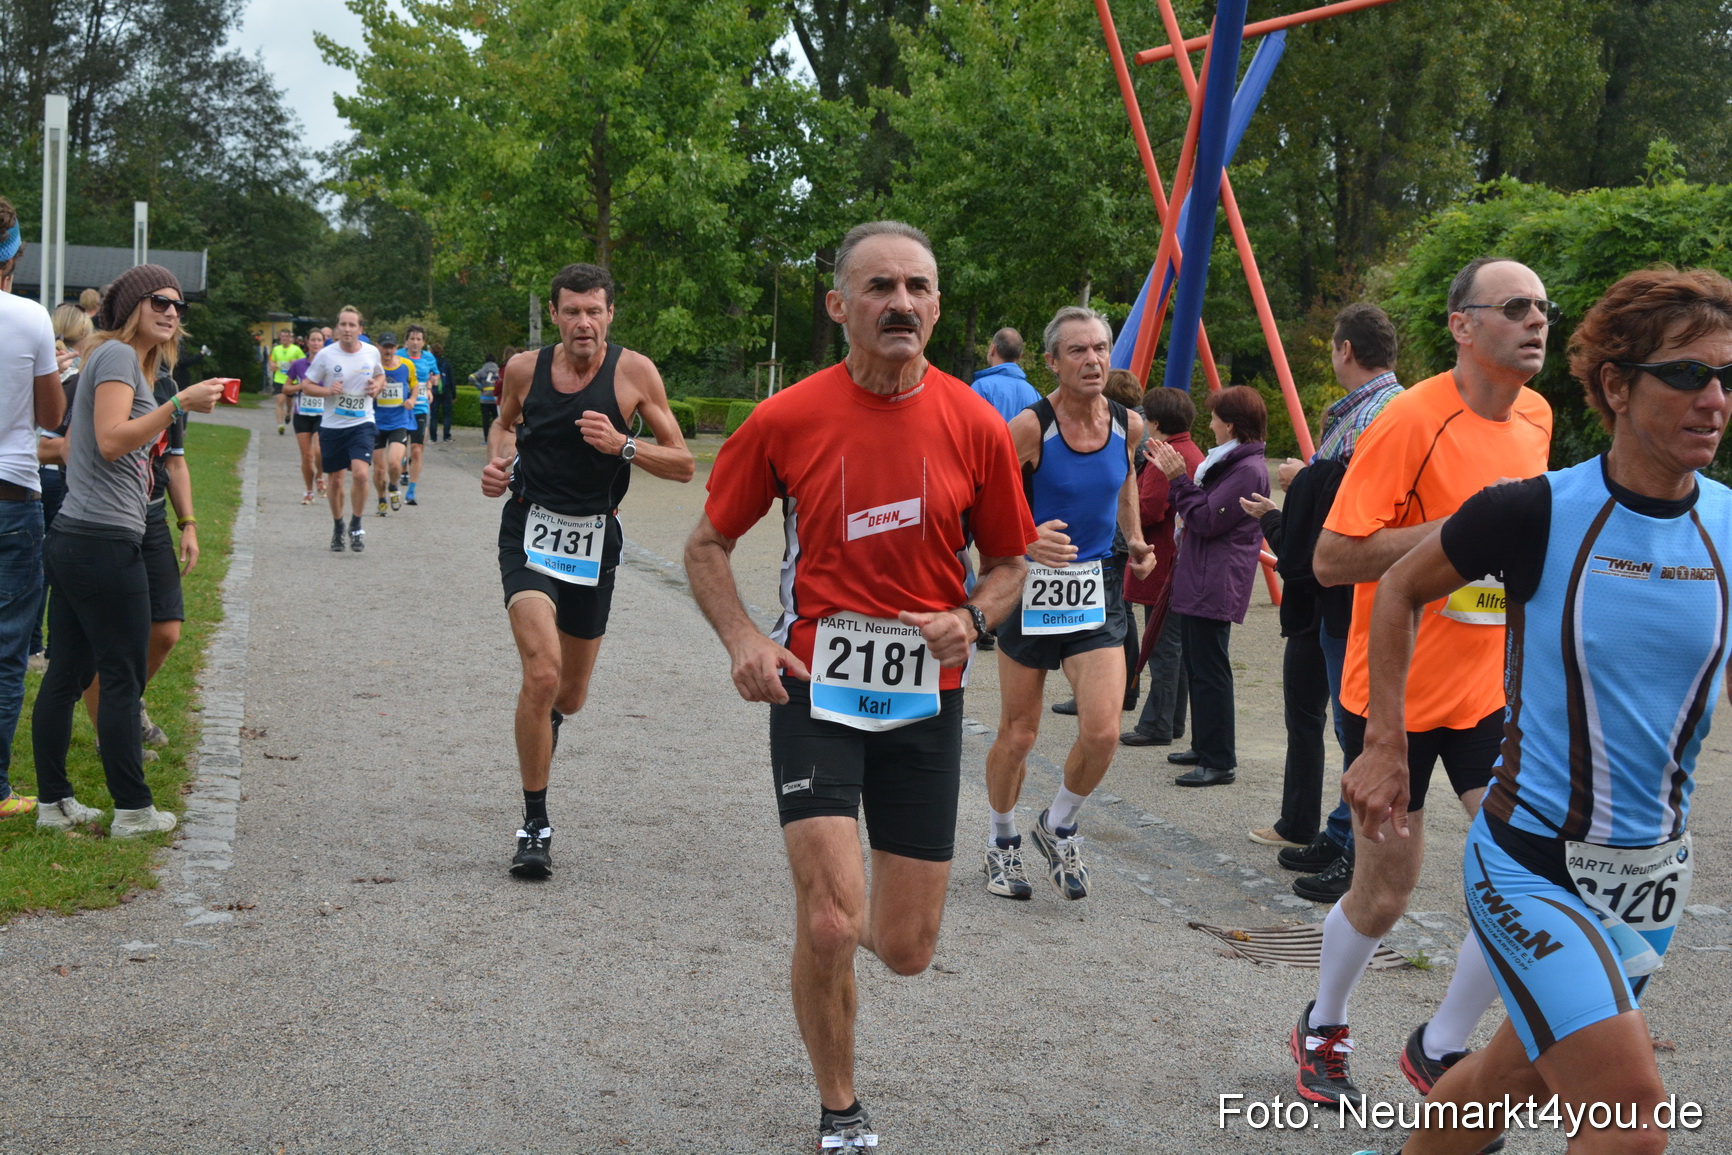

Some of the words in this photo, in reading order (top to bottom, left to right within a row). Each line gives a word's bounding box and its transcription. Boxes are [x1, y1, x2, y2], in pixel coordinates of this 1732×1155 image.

[338, 396, 365, 409] 2928
[530, 510, 555, 524] PARTL
[557, 518, 593, 529] Neumarkt
[868, 510, 900, 528] DEHN
[532, 524, 594, 557] 2131
[544, 558, 577, 573] Rainer
[1027, 568, 1052, 576] ARTL
[1031, 579, 1097, 606] 2302
[820, 617, 862, 632] PARTL
[865, 622, 922, 637] Neumarkt
[1042, 613, 1085, 625] Gerhard
[825, 636, 926, 687] 2181
[858, 695, 892, 715] Karl
[1568, 856, 1616, 875] PARTL
